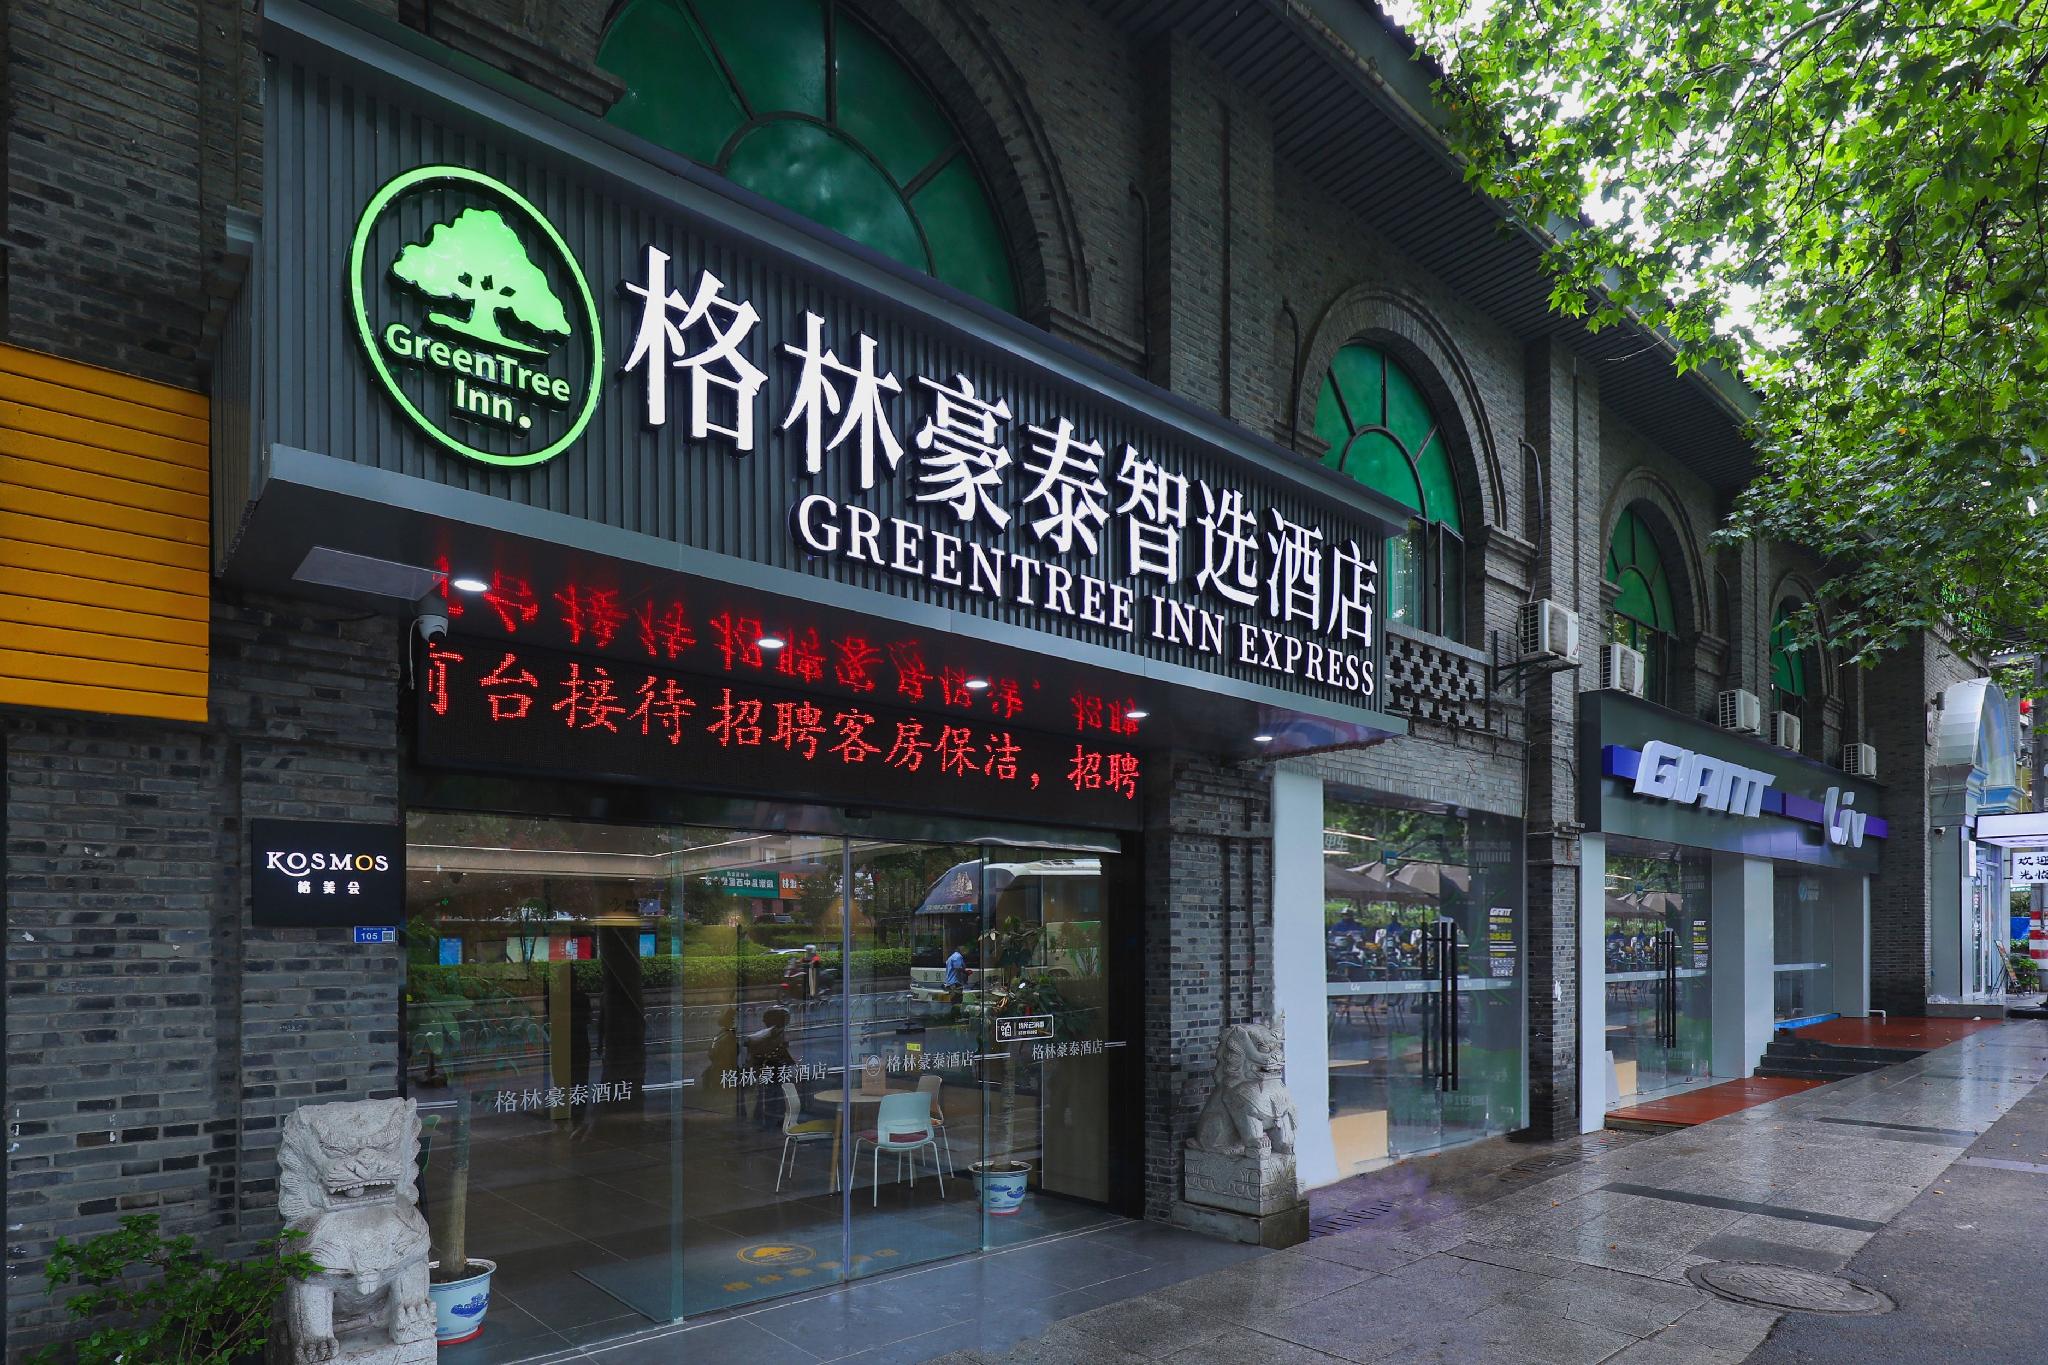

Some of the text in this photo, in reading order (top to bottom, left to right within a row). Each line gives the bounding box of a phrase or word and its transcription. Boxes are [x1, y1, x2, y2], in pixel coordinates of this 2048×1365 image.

[386, 323, 571, 402] GreenTree
[624, 246, 1378, 648] 格林豪泰智选酒店
[799, 494, 1374, 696] GREENTREE INN EXPRESS
[1633, 740, 1776, 818] GIANT
[1823, 786, 1867, 848] Liv
[266, 851, 389, 877] KOSMOS
[361, 932, 378, 940] 105
[886, 1050, 975, 1073] 格林豪泰酒店
[1031, 1038, 1104, 1060] 格林豪泰酒店
[719, 1062, 827, 1089] 格林豪泰酒店
[493, 1080, 633, 1113] 格林豪泰酒店
